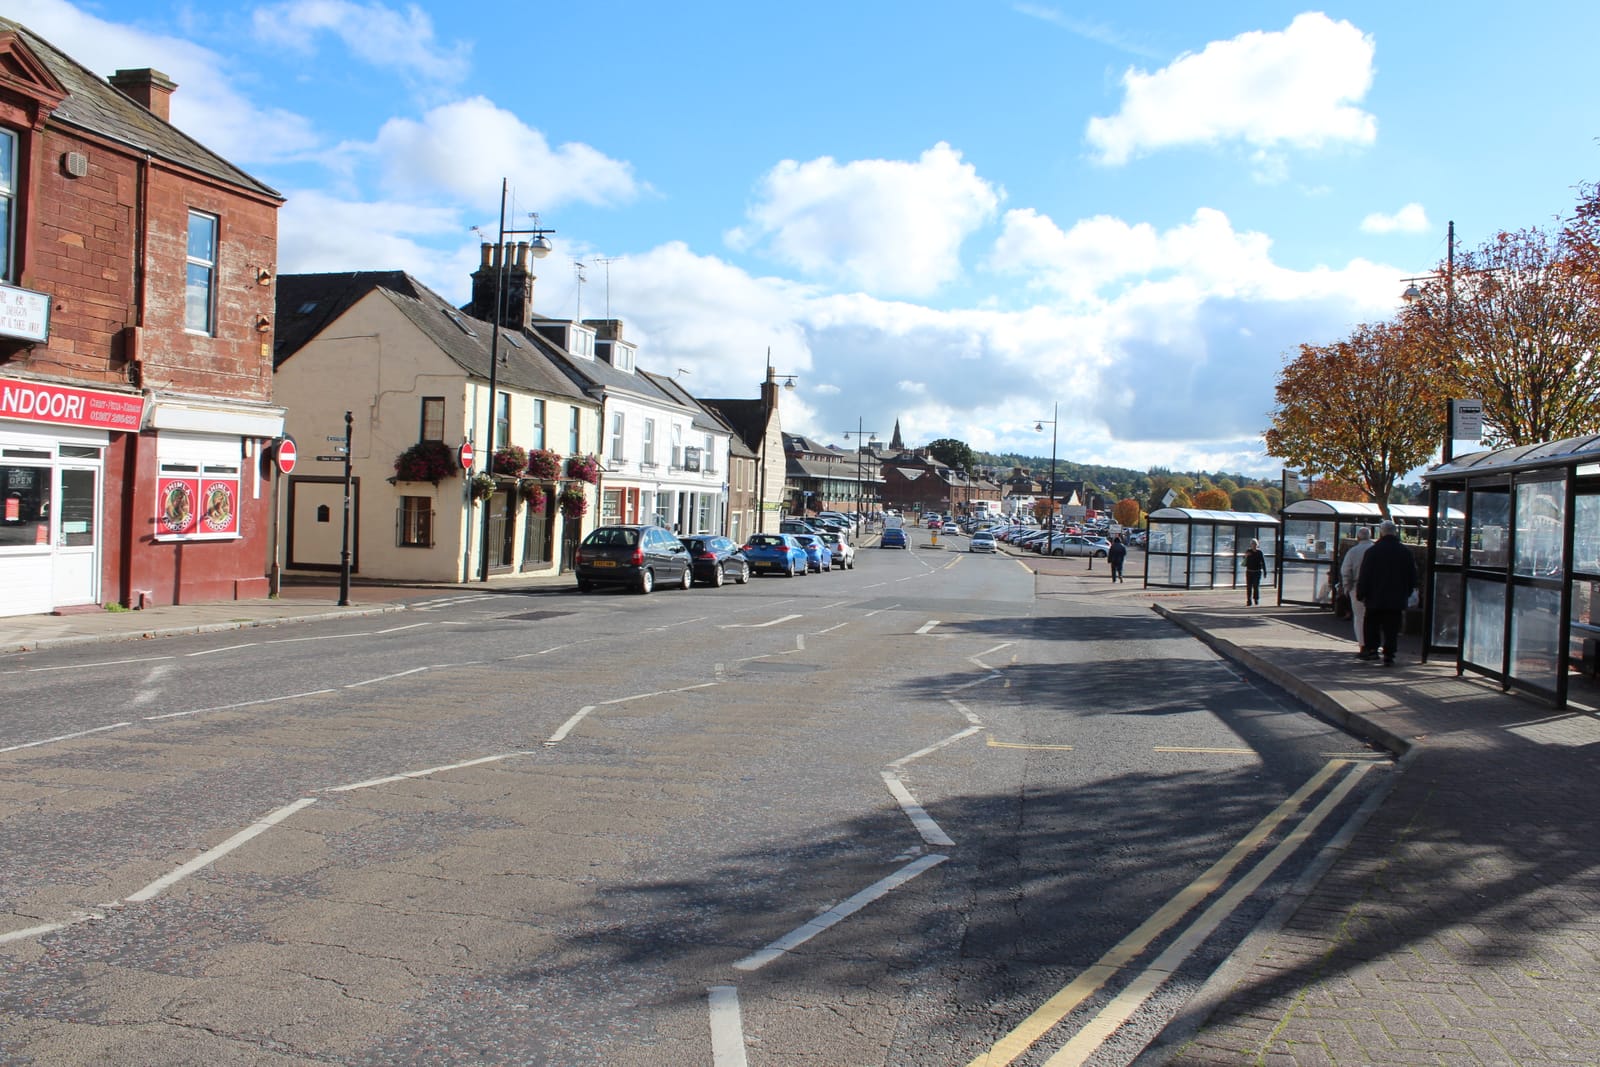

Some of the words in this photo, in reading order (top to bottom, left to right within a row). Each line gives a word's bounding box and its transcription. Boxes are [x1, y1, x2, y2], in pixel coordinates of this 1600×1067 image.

[0, 386, 87, 420] NDOORI
[9, 476, 33, 485] OPEN
[164, 480, 192, 496] SHIMLA
[206, 482, 232, 497] SHIMLA
